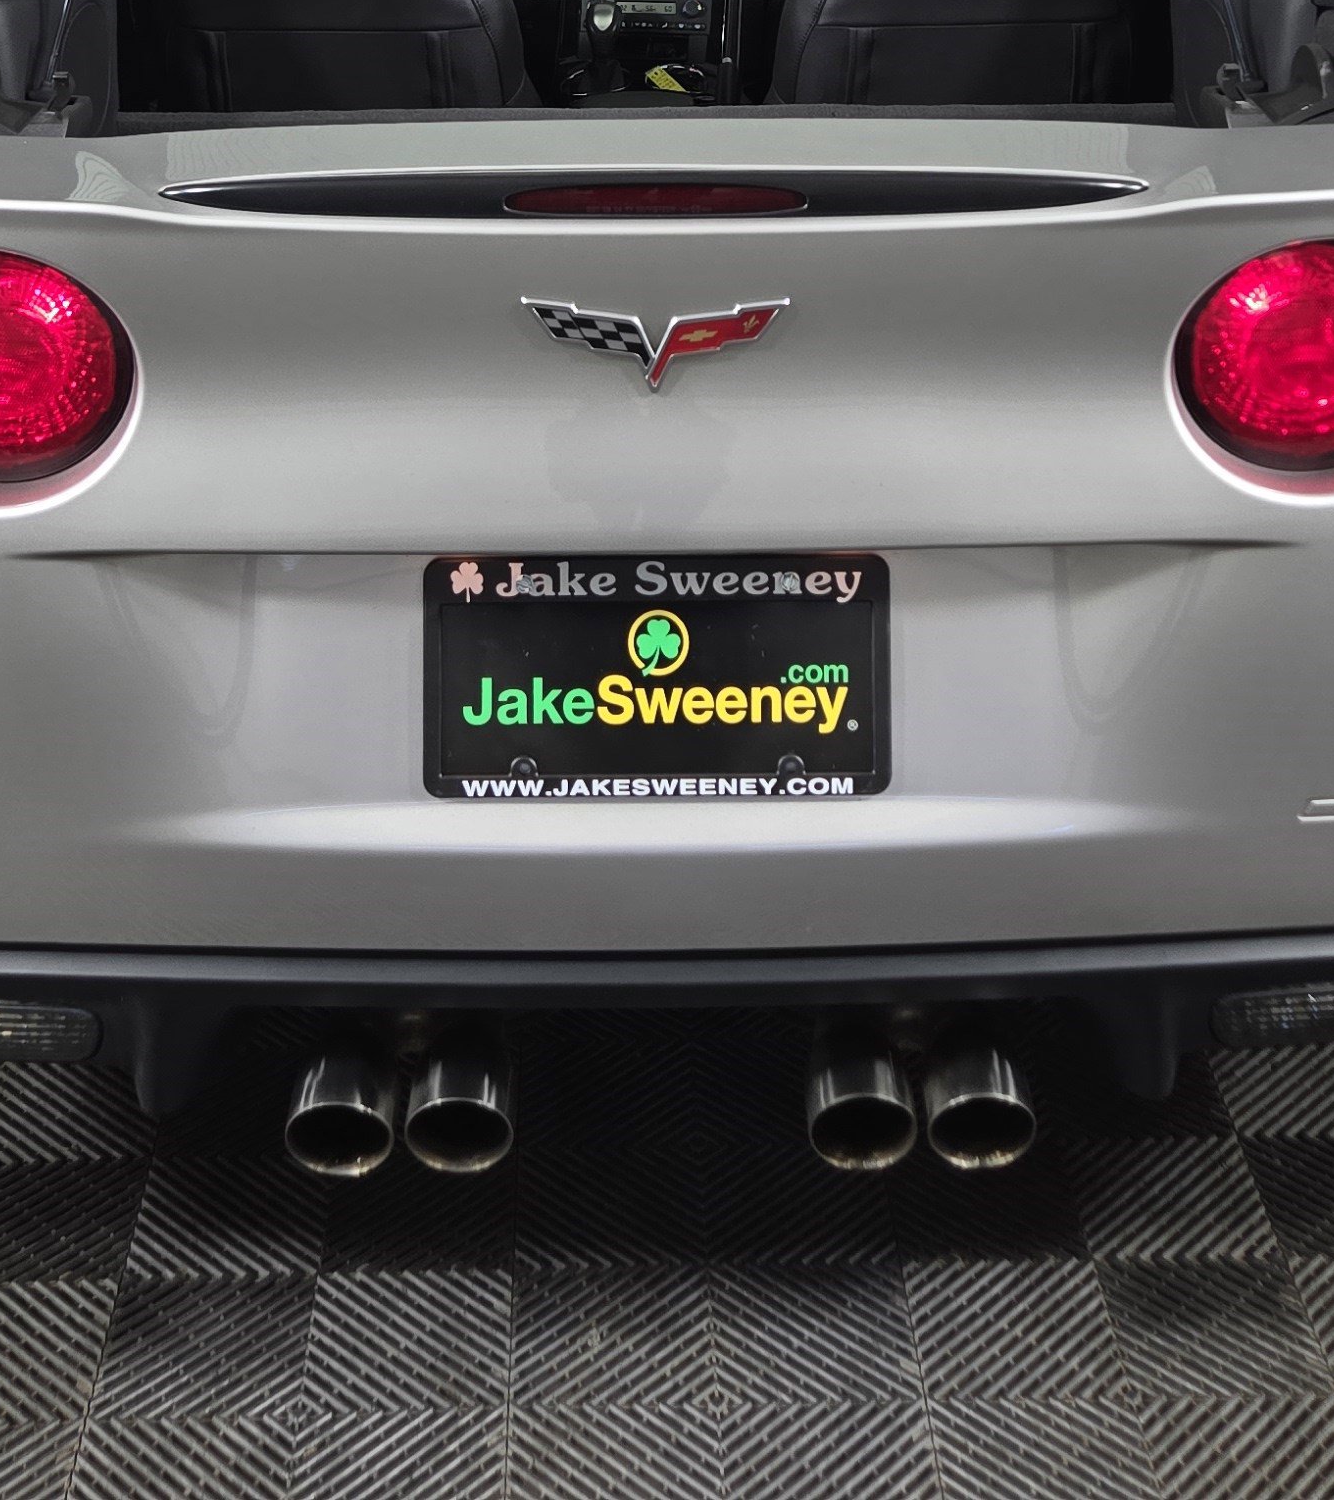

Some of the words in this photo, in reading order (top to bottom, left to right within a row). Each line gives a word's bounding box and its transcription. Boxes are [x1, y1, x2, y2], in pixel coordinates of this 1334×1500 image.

[496, 561, 617, 597] Jake
[634, 560, 863, 603] Sweeney
[462, 778, 854, 797] WWW.JAKESWEENEY.COM
